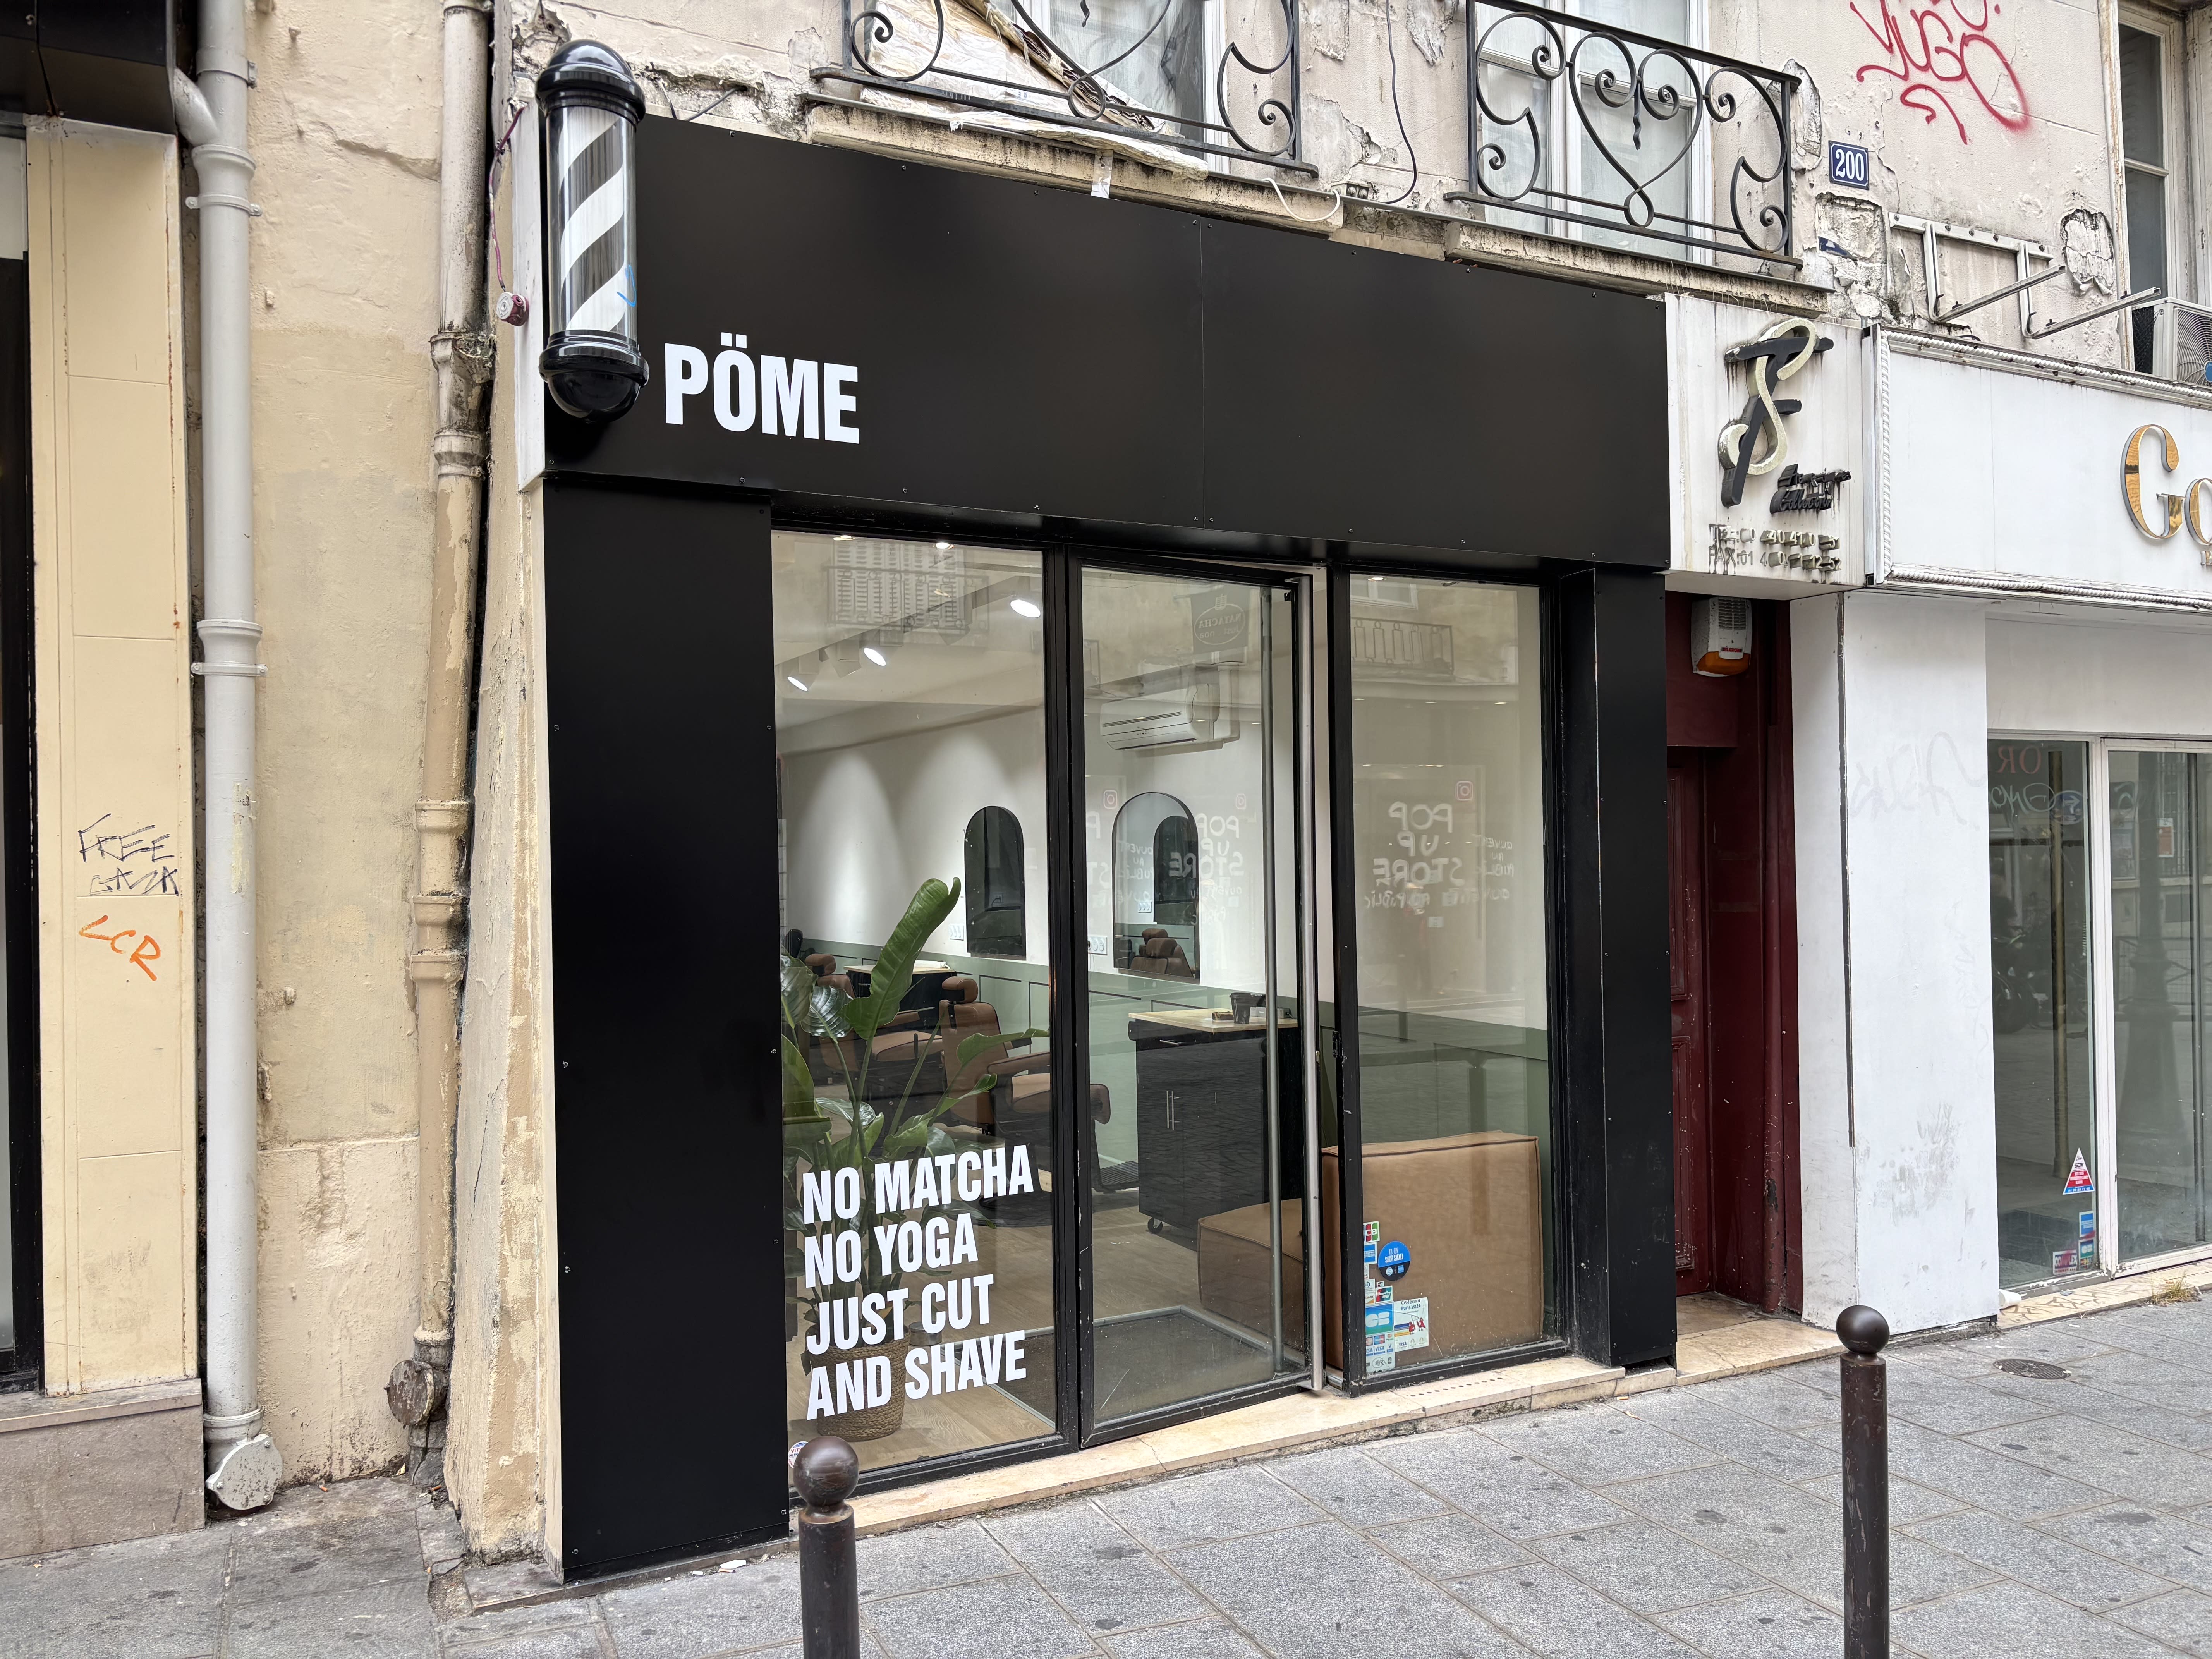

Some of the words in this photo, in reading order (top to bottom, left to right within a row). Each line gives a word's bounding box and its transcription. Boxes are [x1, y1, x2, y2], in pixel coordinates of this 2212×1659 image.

[1835, 148, 1865, 182] 200
[665, 331, 860, 444] PÖME
[77, 813, 175, 862] FREE
[802, 1166, 860, 1224] NO
[874, 1144, 1034, 1214] MATCHA
[804, 1229, 862, 1289] NO
[873, 1213, 979, 1276] YOGA
[1364, 1228, 1377, 1237] CB
[806, 1288, 909, 1355] JUST
[922, 1274, 994, 1334] CUT
[807, 1355, 891, 1421] AND
[905, 1330, 1027, 1400] SHAVE
